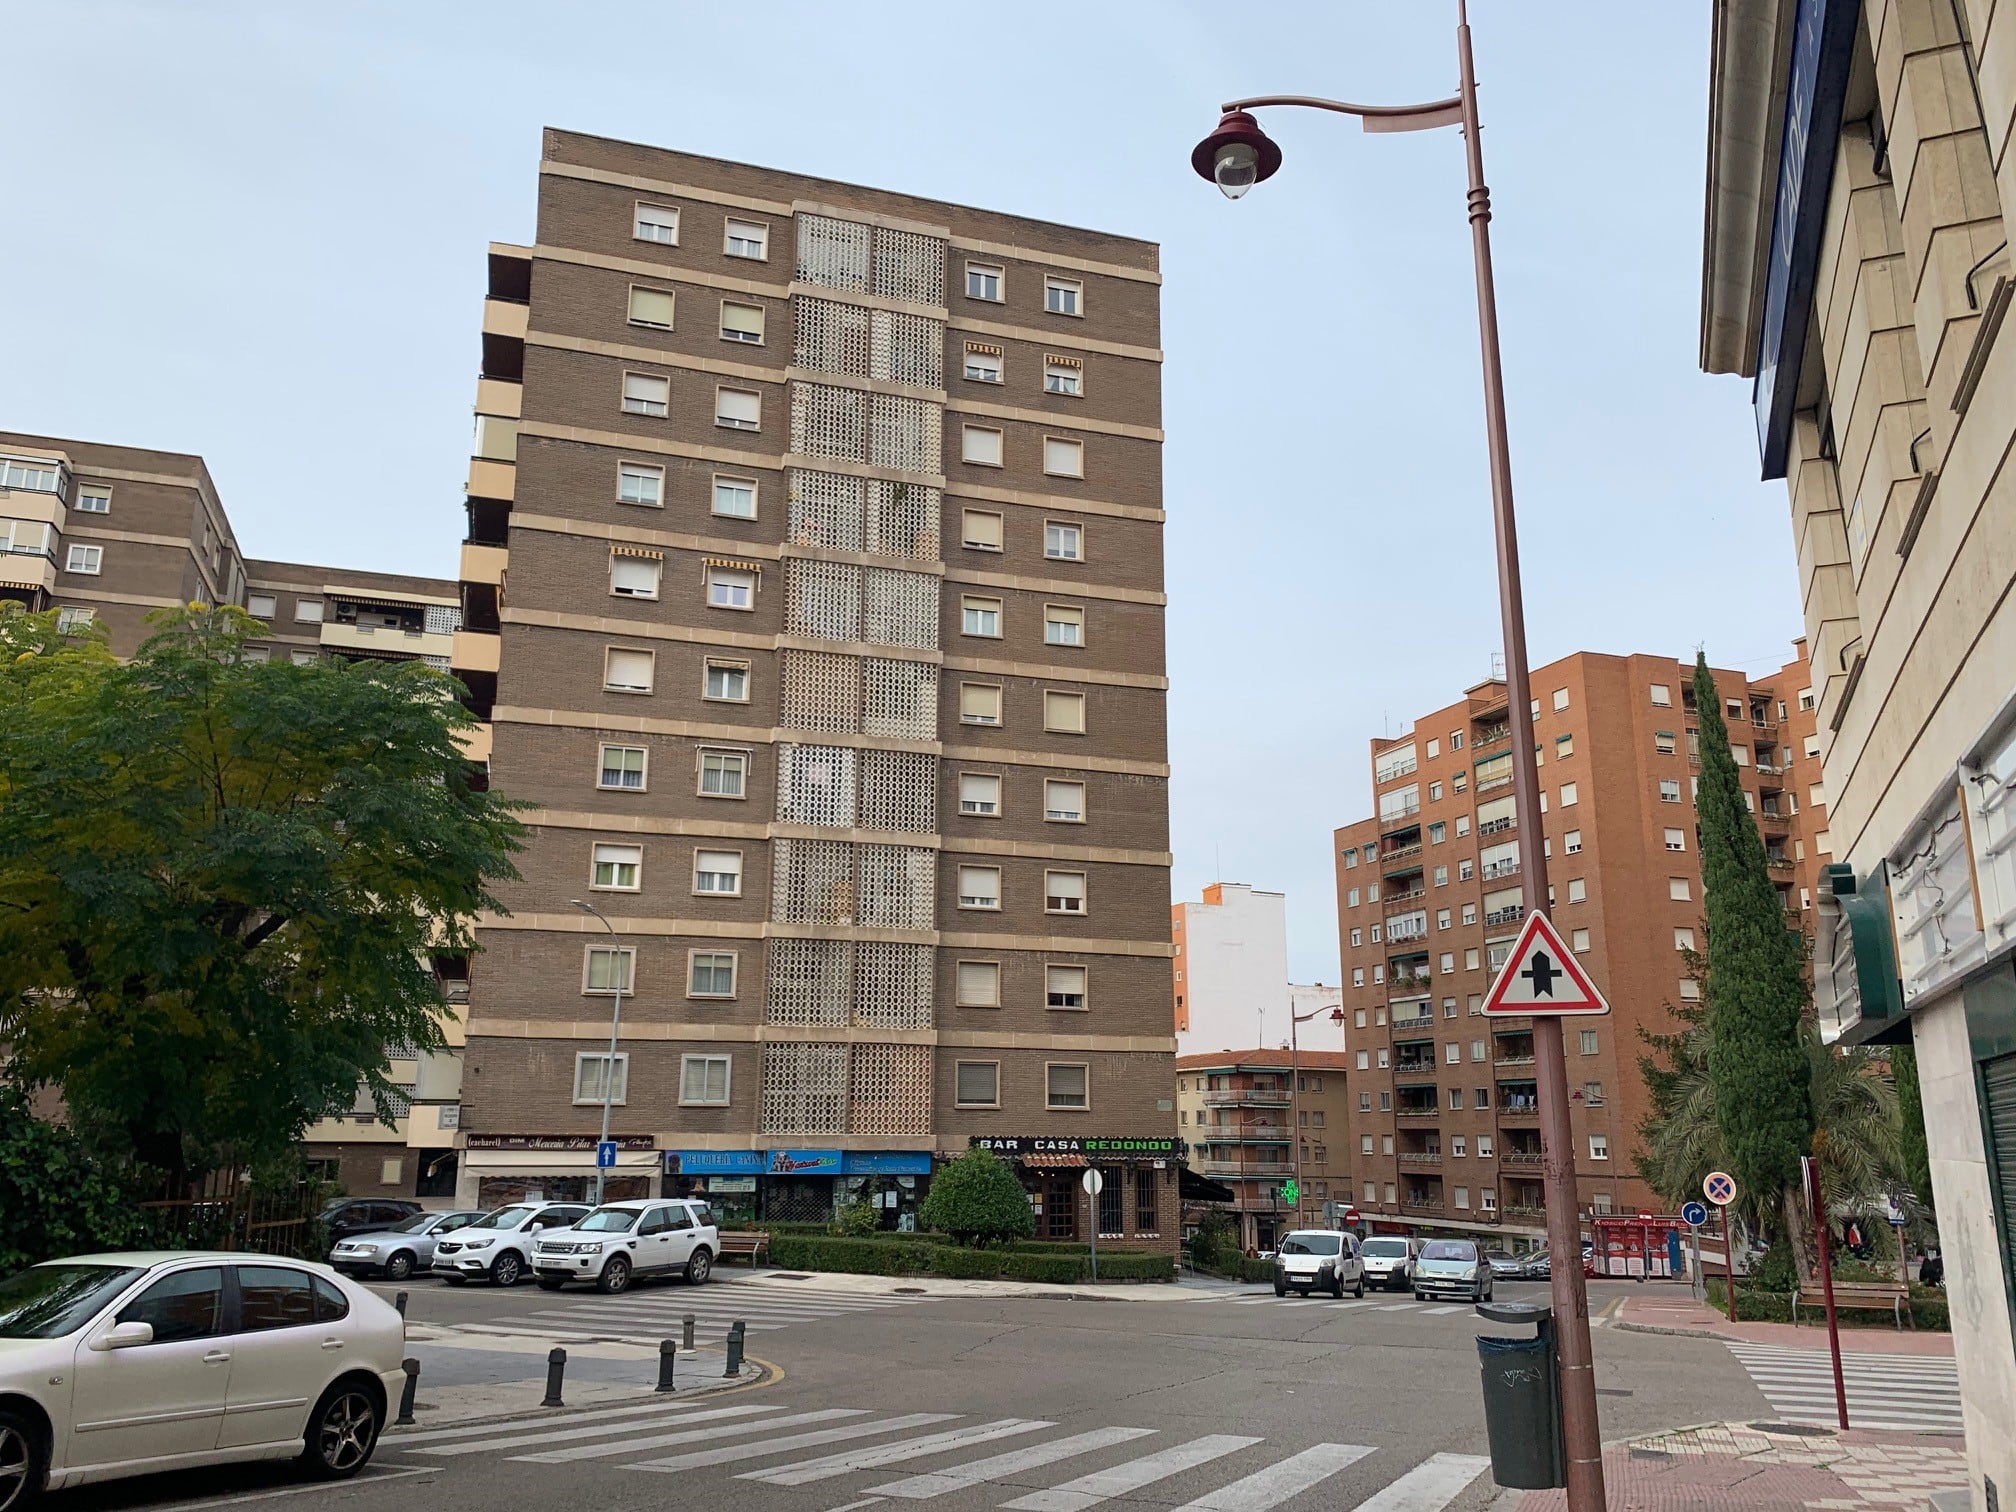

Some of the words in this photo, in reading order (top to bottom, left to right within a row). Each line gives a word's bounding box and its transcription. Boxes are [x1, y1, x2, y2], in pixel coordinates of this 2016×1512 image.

[1781, 68, 1807, 267] CADE
[980, 1140, 1018, 1150] BAR
[1034, 1140, 1080, 1151] CASA
[1085, 1140, 1173, 1151] REDONDO
